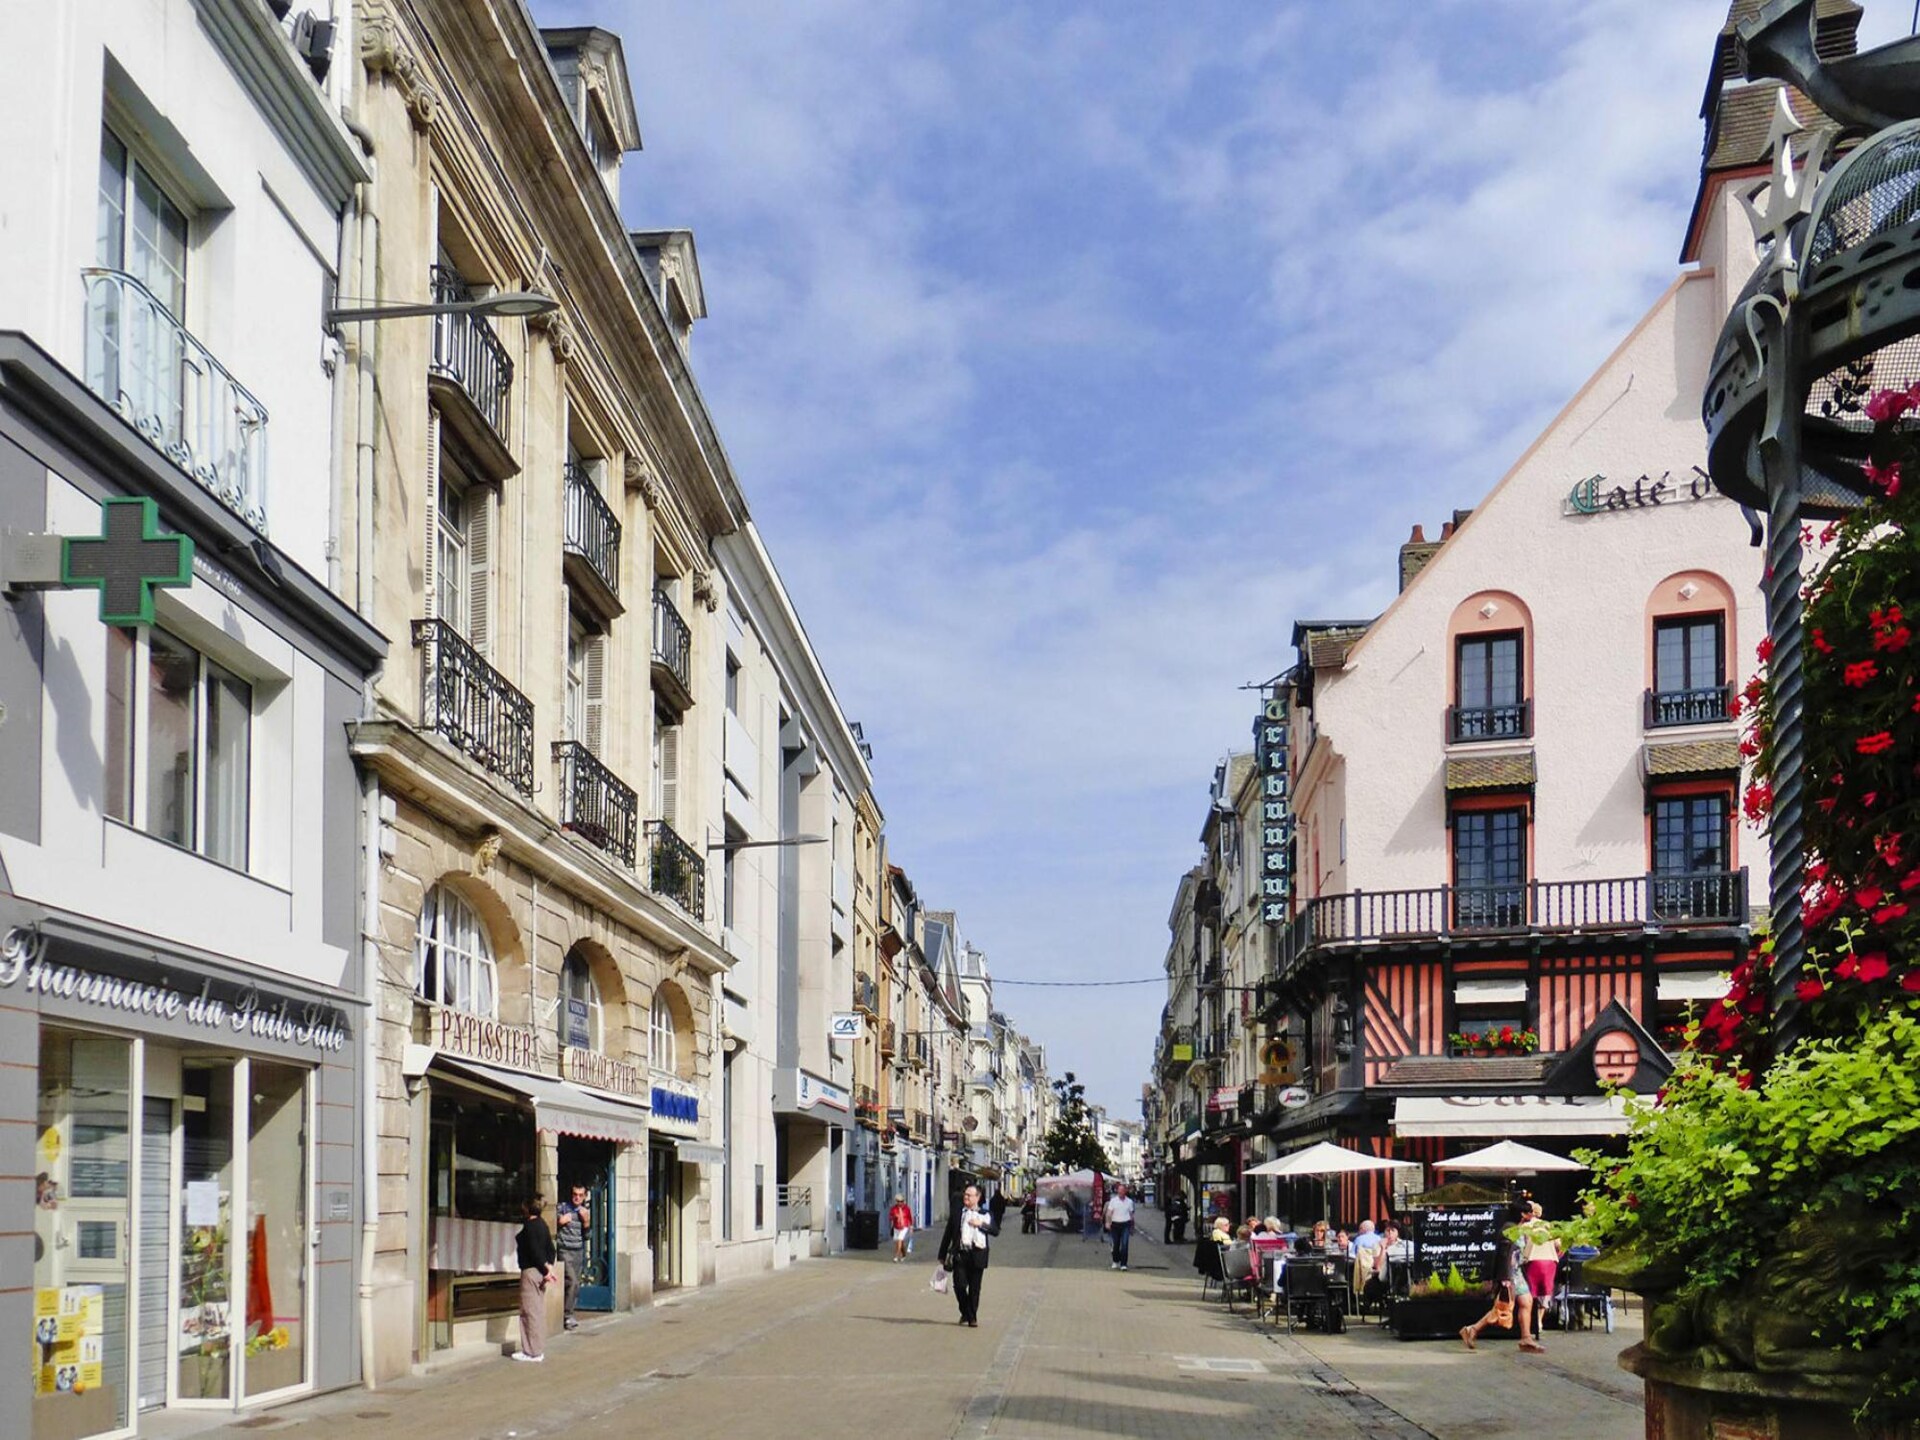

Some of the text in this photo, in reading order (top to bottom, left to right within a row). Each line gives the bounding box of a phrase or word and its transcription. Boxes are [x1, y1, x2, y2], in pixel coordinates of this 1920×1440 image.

[1569, 470, 1670, 513] Café
[1264, 699, 1286, 920] Tribunaux
[0, 922, 183, 1017] Pharmacie
[184, 977, 226, 1026] du
[230, 980, 297, 1041] Puits
[440, 1009, 532, 1070] PATISSIER
[572, 1048, 639, 1096] CHOCOLATIER
[1427, 1212, 1448, 1221] Plat
[1449, 1212, 1460, 1221] du
[1421, 1242, 1466, 1254] Suggestion
[1468, 1242, 1480, 1251] du
